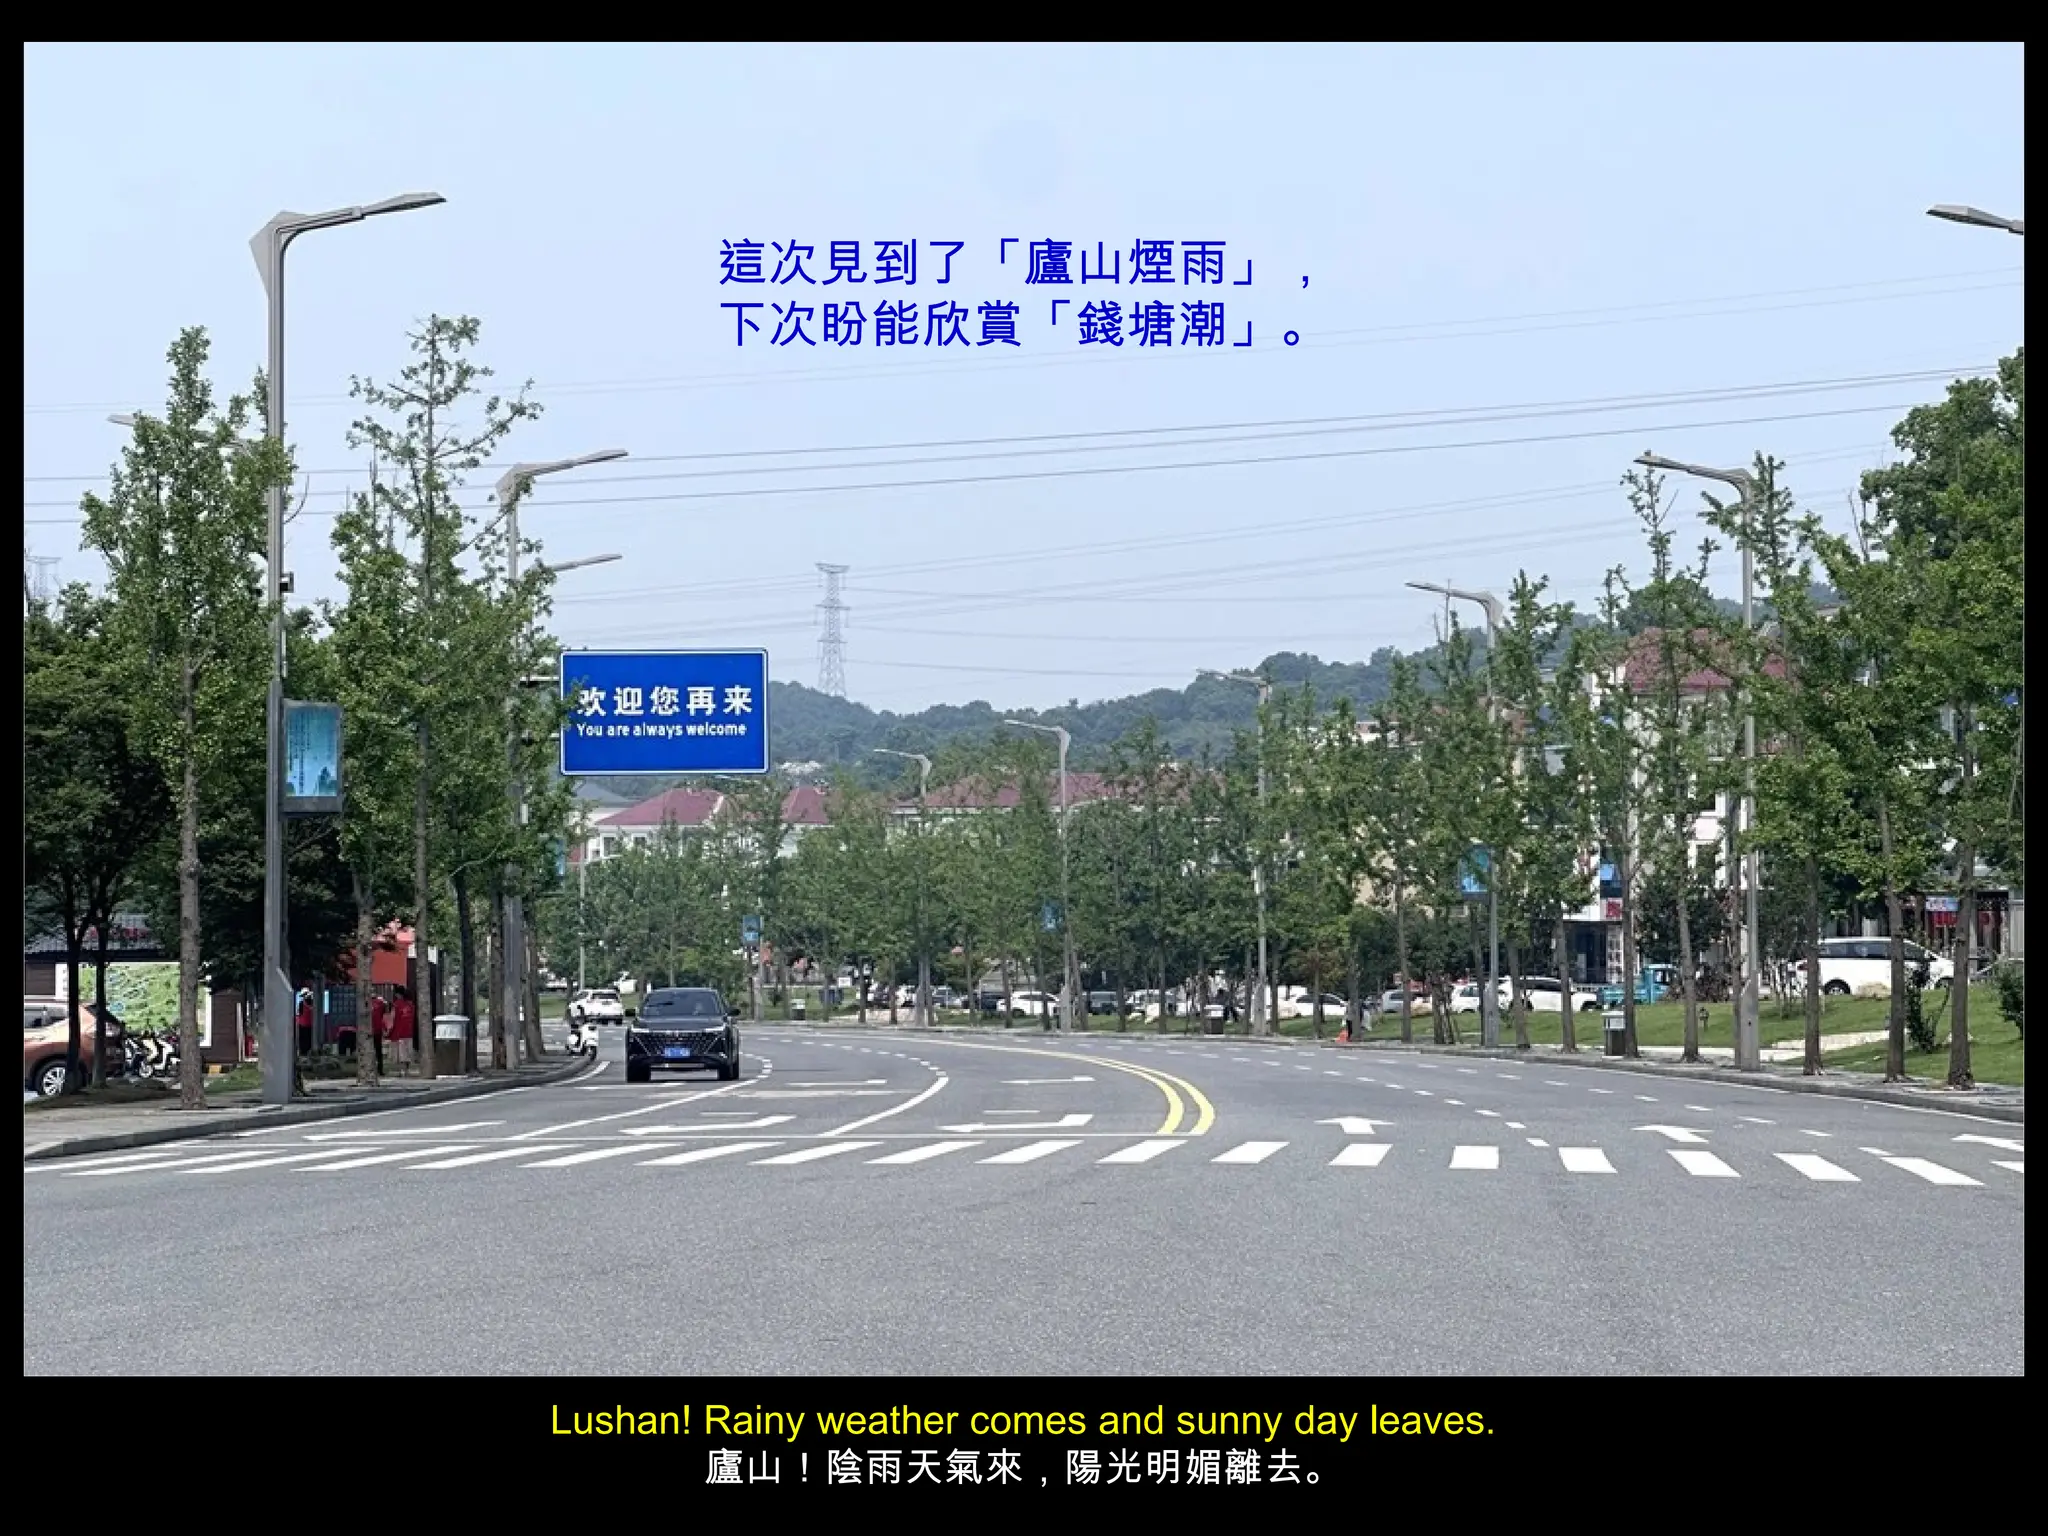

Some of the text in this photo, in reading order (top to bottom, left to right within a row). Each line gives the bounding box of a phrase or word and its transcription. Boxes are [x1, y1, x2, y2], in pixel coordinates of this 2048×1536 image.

[577, 685, 753, 717] 欢迎您再来
[576, 721, 748, 740] You are always welcome
